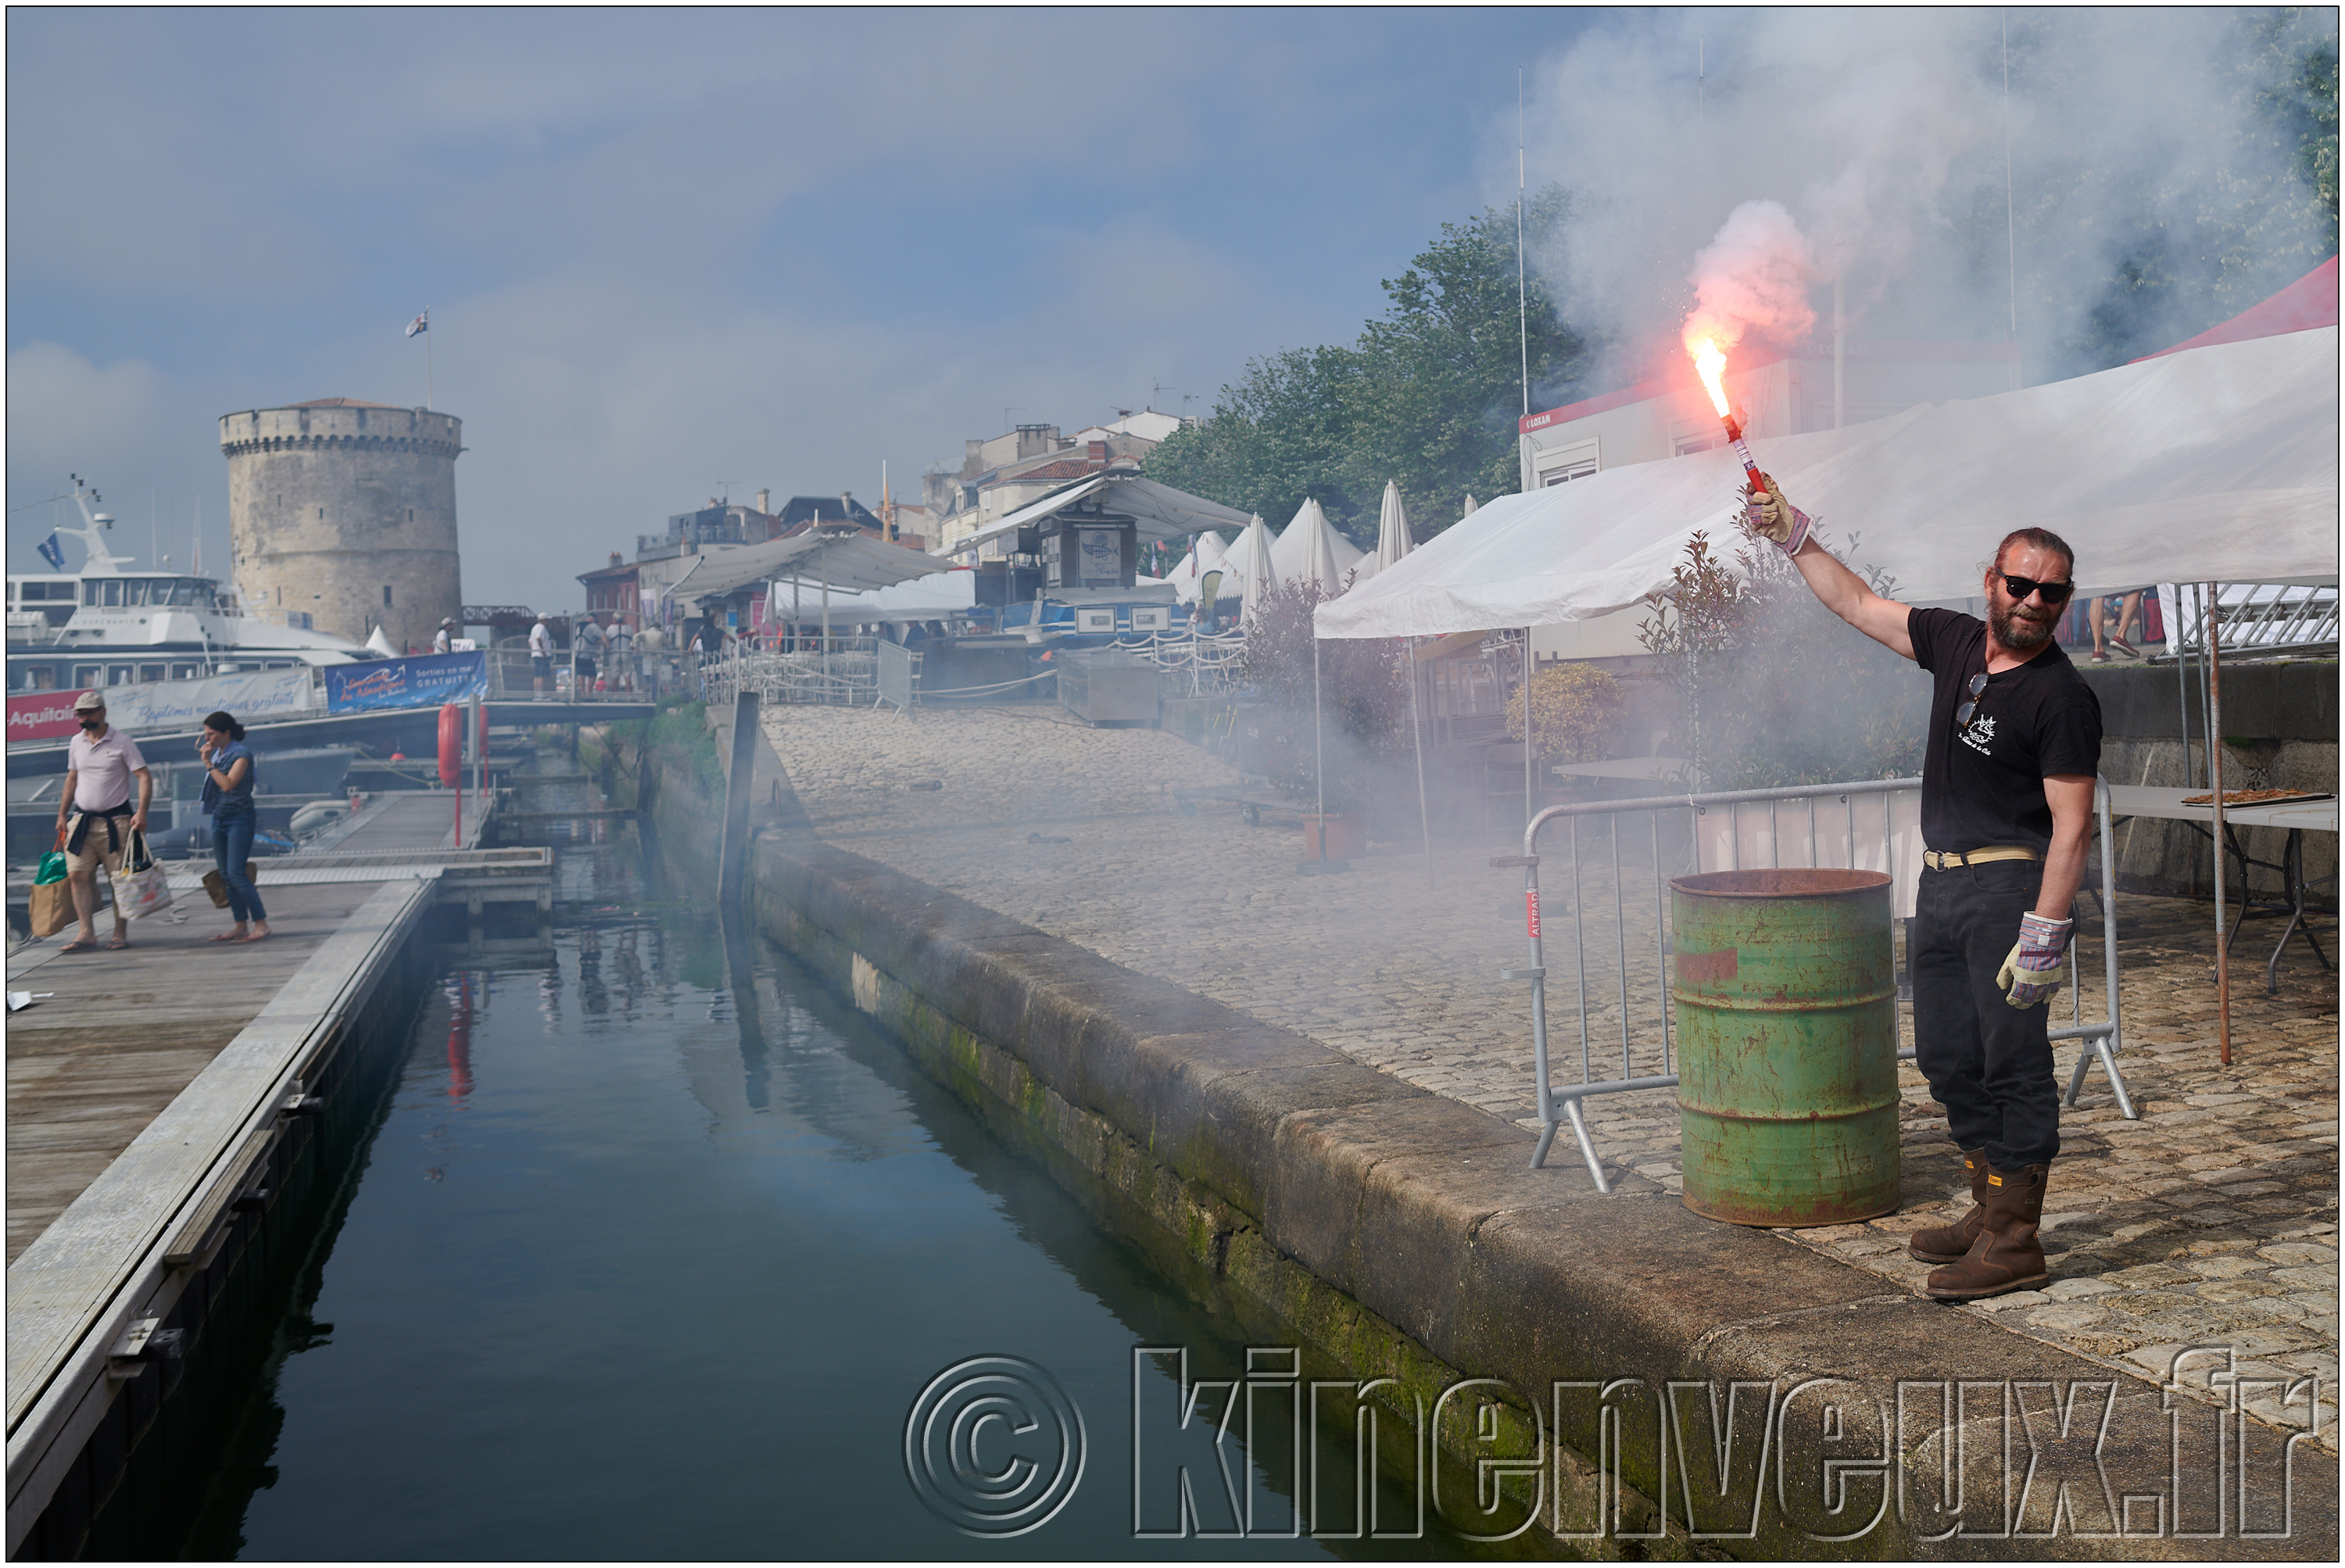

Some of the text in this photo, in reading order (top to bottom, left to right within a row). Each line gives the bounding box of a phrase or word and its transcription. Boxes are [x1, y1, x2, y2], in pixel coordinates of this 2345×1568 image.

[1531, 414, 1551, 428] LOXAM
[416, 668, 446, 678] Sorties
[356, 678, 405, 697] Nautisme
[417, 674, 477, 688] GRATUITES
[249, 691, 294, 714] gratuits
